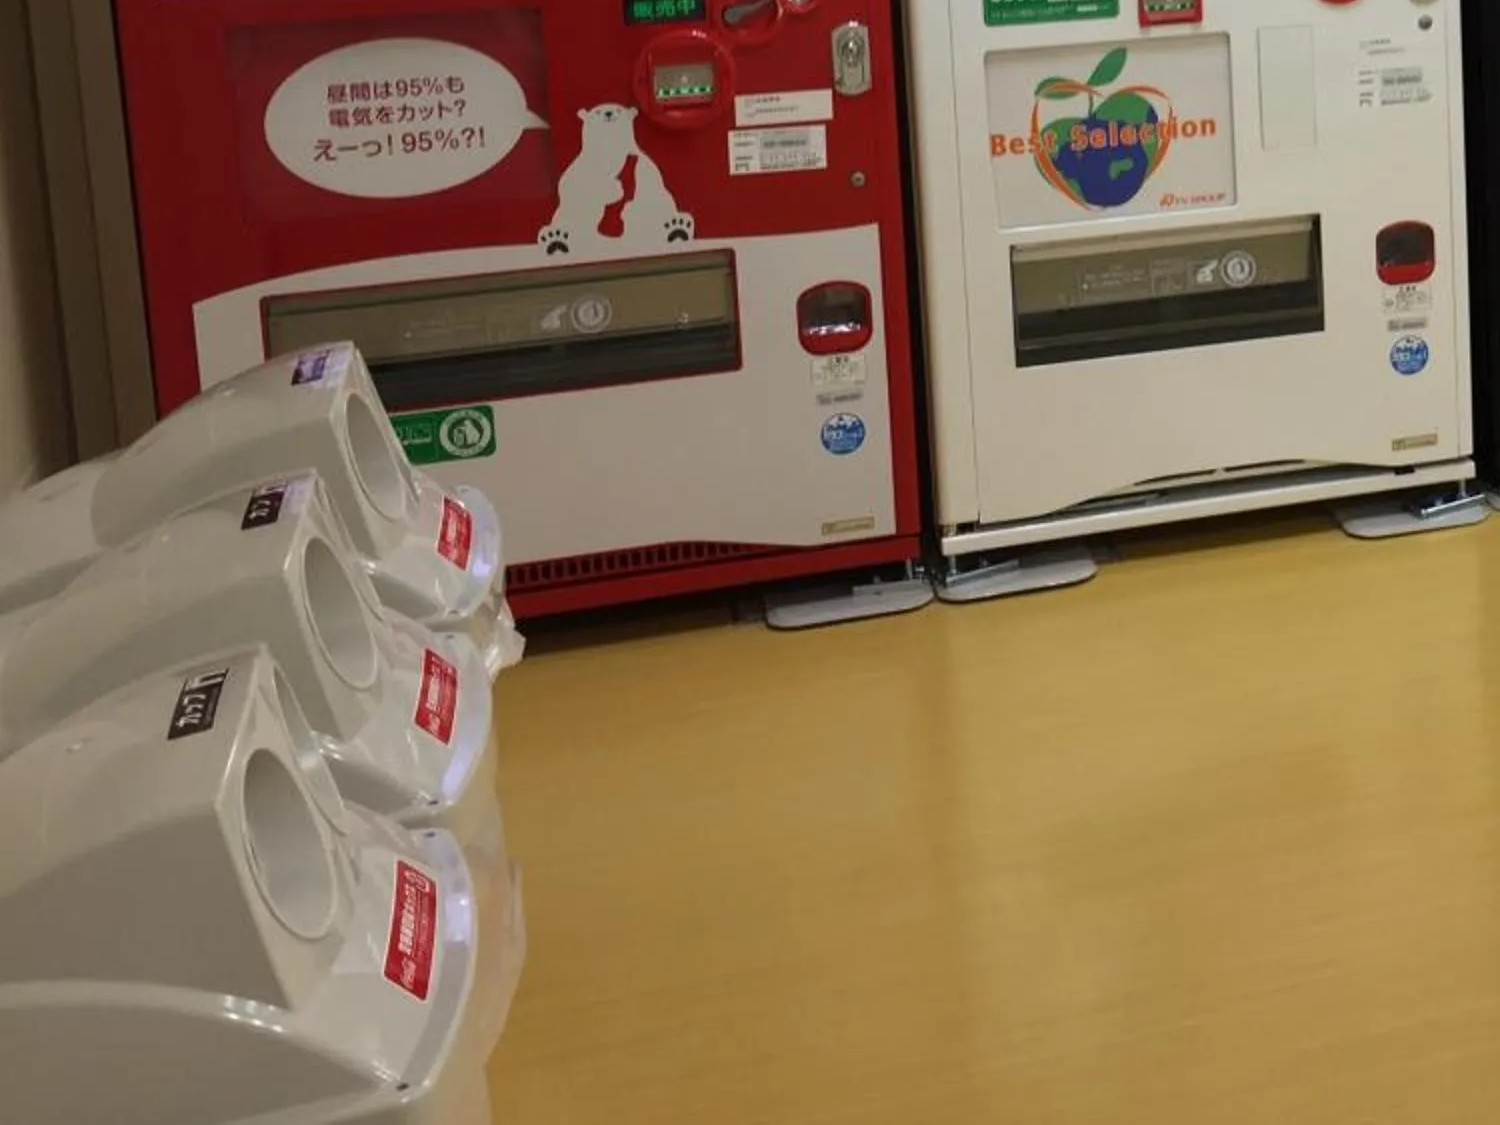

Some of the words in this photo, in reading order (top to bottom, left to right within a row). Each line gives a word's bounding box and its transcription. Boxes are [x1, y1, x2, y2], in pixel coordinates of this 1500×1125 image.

[327, 76, 464, 104] 昼間は95%も
[989, 131, 1058, 157] Best
[1070, 116, 1217, 152] Selection
